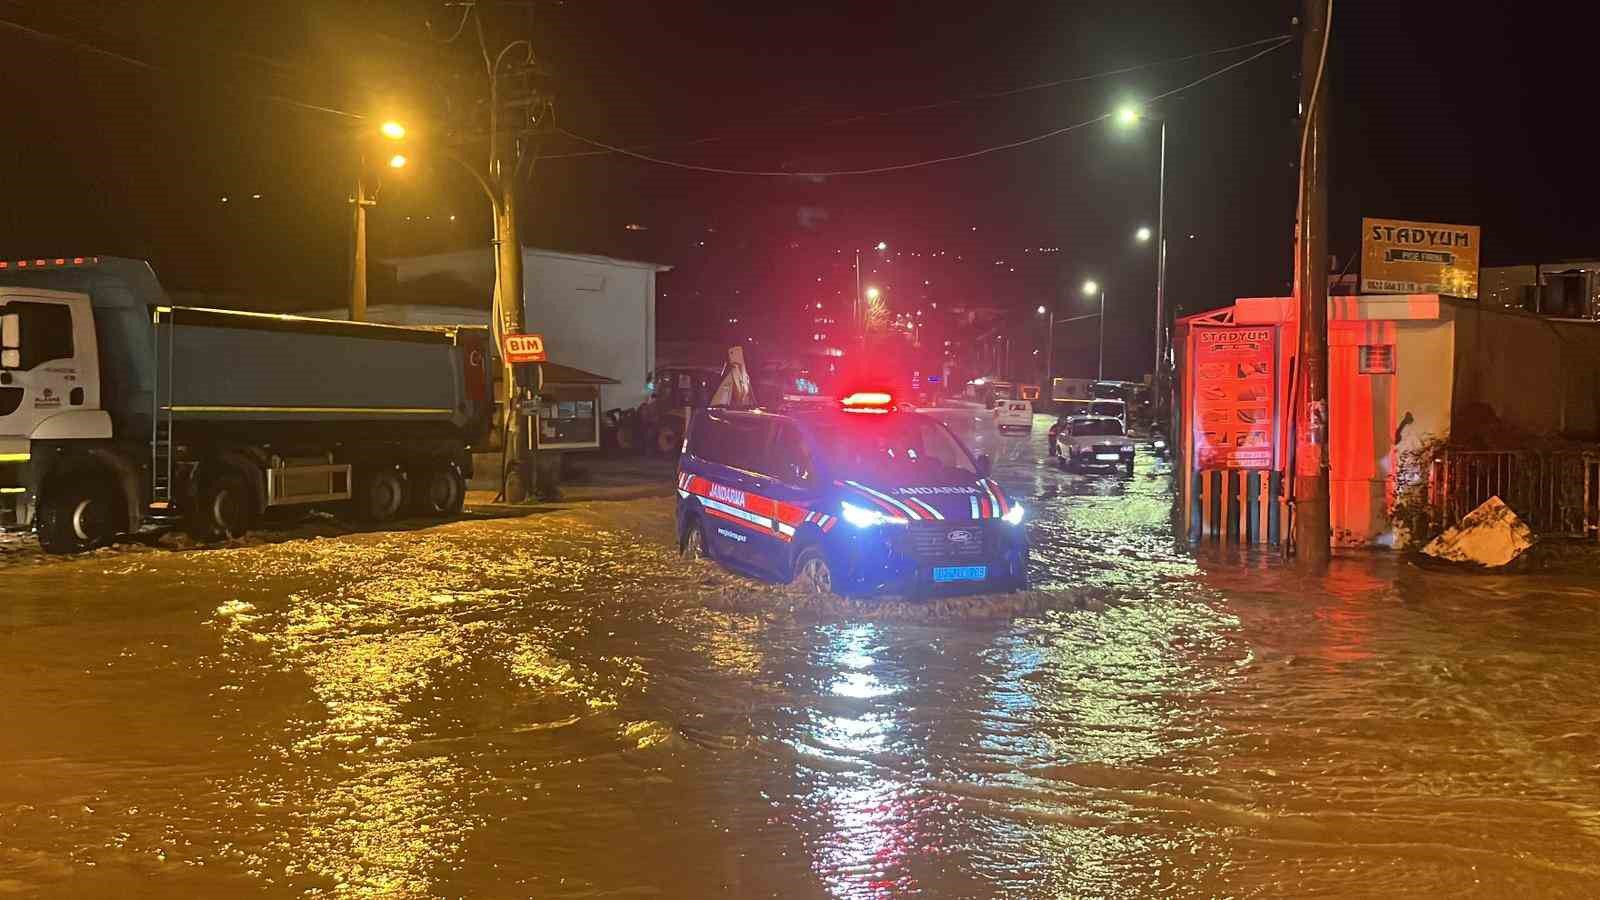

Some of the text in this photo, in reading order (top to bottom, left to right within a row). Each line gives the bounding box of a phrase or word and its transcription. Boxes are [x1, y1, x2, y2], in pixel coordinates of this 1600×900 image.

[1372, 225, 1468, 247] STADYUM
[1201, 331, 1269, 342] STADYUM
[709, 482, 746, 508] JANDARMA
[890, 486, 978, 496] JANDARMA
